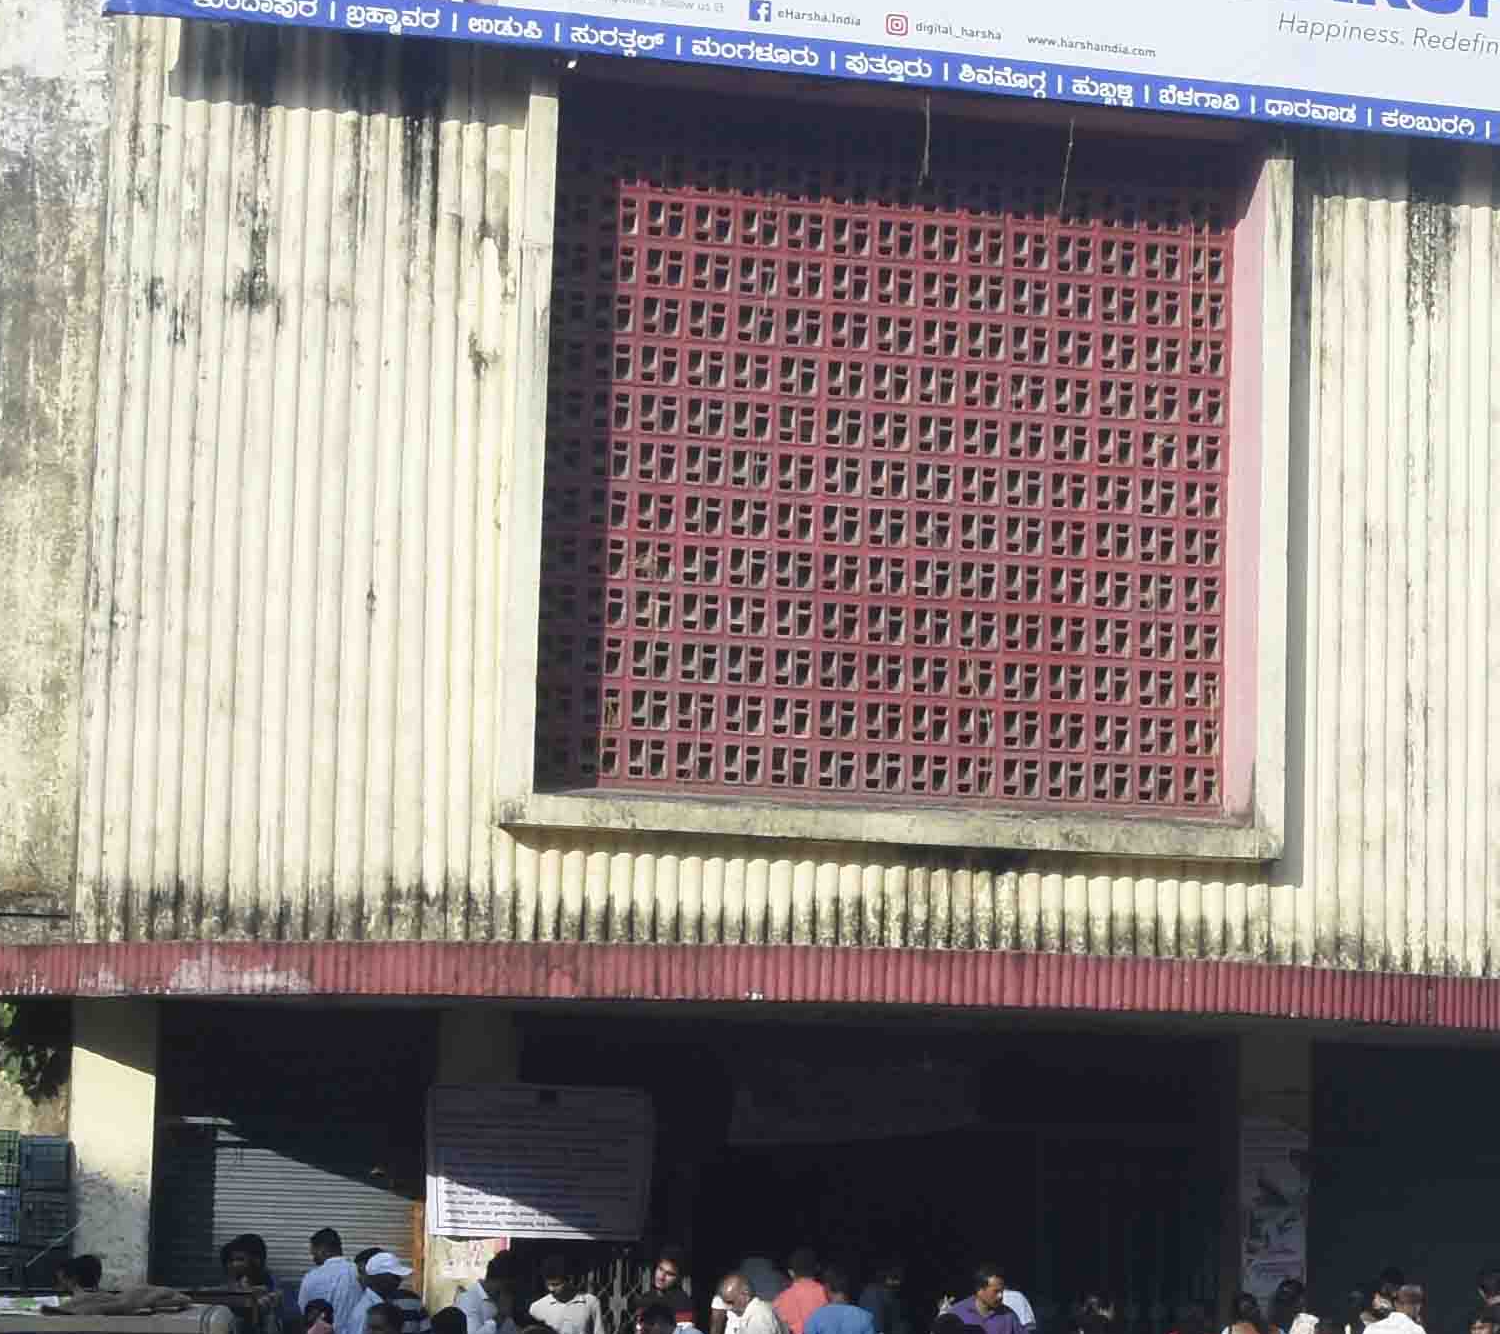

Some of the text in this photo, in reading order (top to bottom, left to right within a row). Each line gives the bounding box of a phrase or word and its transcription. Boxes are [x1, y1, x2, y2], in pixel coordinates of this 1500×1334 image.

[915, 20, 1002, 41] digital_harsha
[1278, 12, 1405, 47] Happiness.
[1027, 33, 1157, 58] www.harshaindia.com
[468, 17, 543, 40] ಉಡುಪಿ
[692, 35, 819, 67] ಮಂಗಳೂರು
[845, 52, 932, 83] ಪುತ್ತೂರು
[958, 62, 1047, 98] ಶಿವಮೊಗ್ಗ
[1159, 87, 1240, 111] ಬೆಳಗಾವಿ
[1265, 98, 1357, 124] ಧಾರವಾಡ
[1381, 110, 1476, 136] ಕಲಬುರಗಿ
